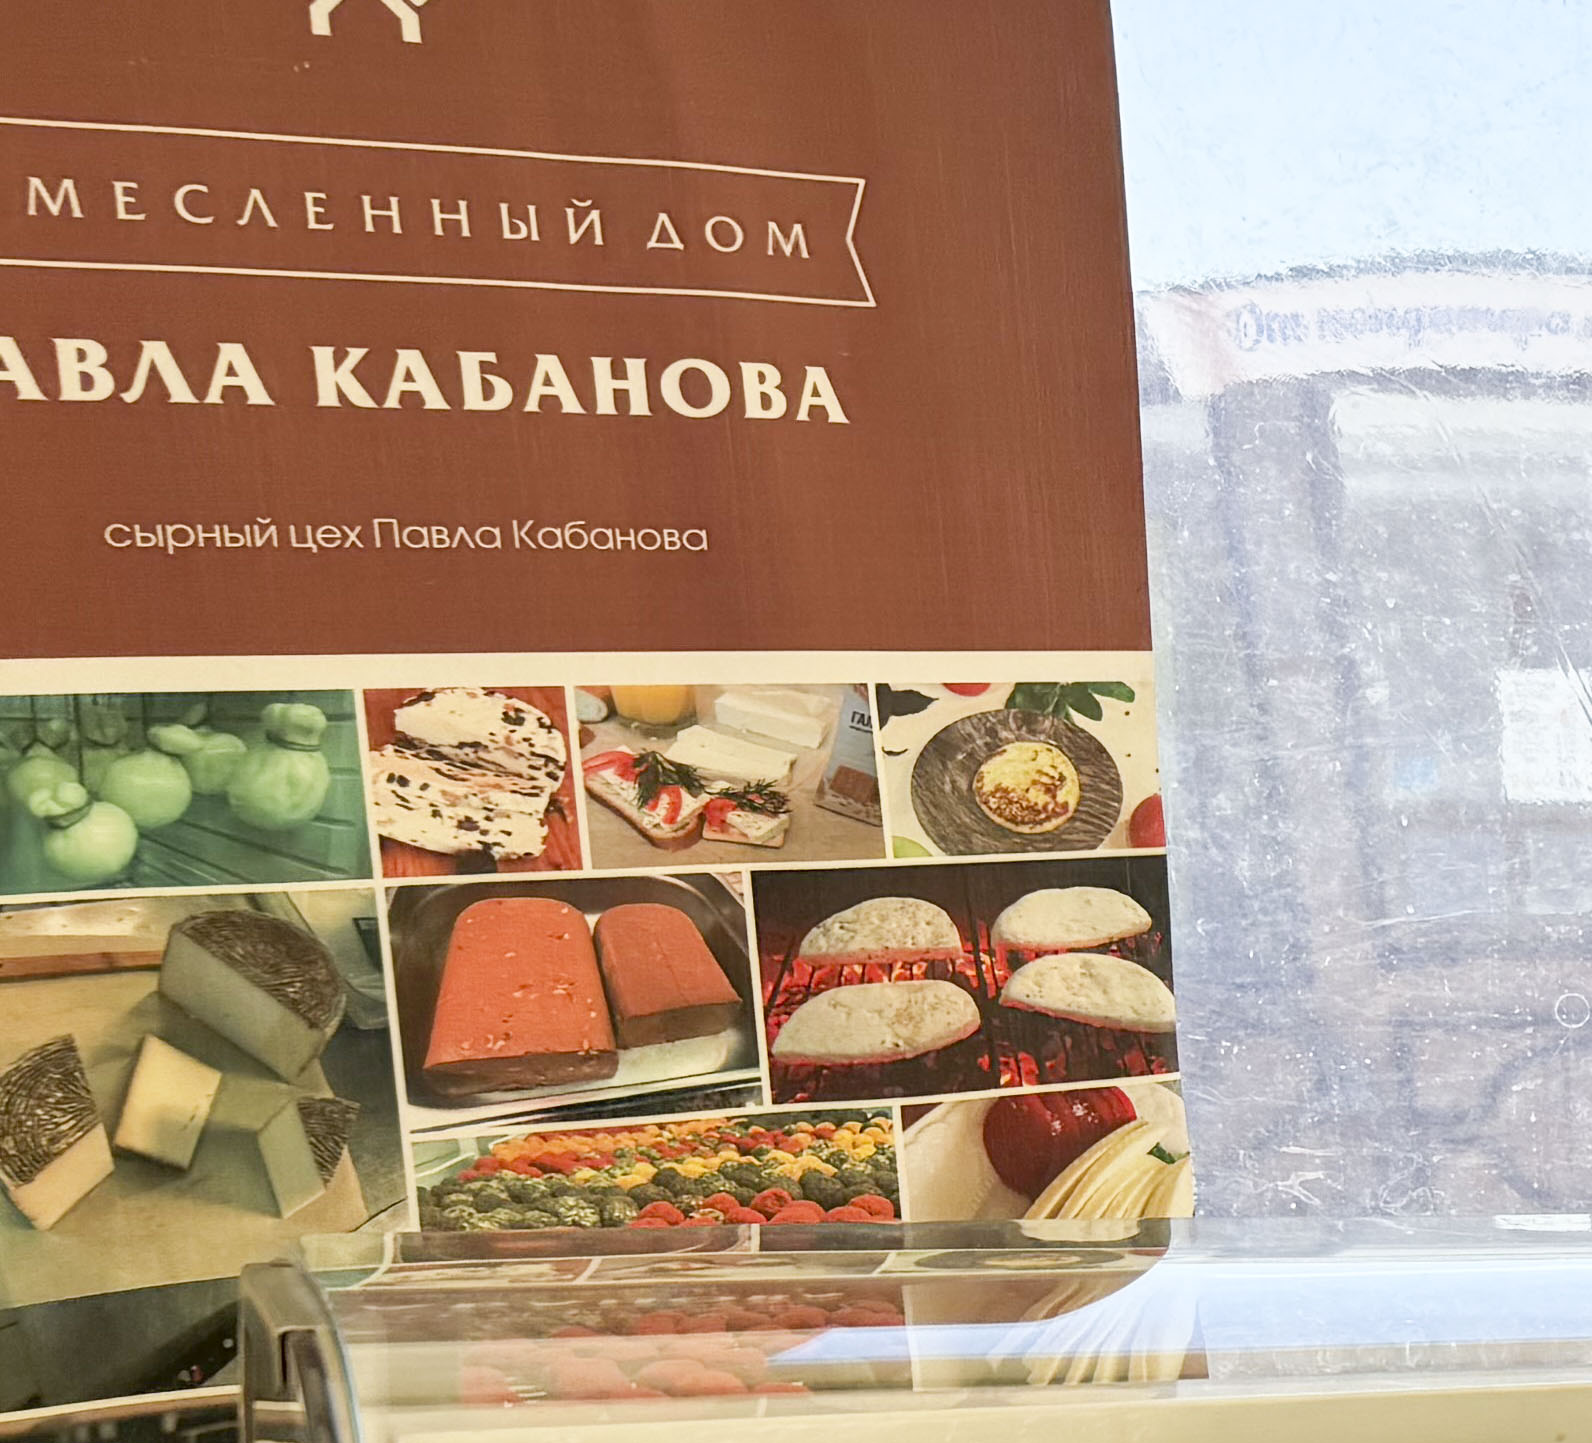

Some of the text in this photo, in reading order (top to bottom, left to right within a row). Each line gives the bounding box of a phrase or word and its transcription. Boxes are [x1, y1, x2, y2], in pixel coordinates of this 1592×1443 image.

[646, 212, 811, 260] ДОМ
[311, 346, 850, 425] КАБАНОВА
[104, 516, 709, 553] сырный цех Павла Кабанова
